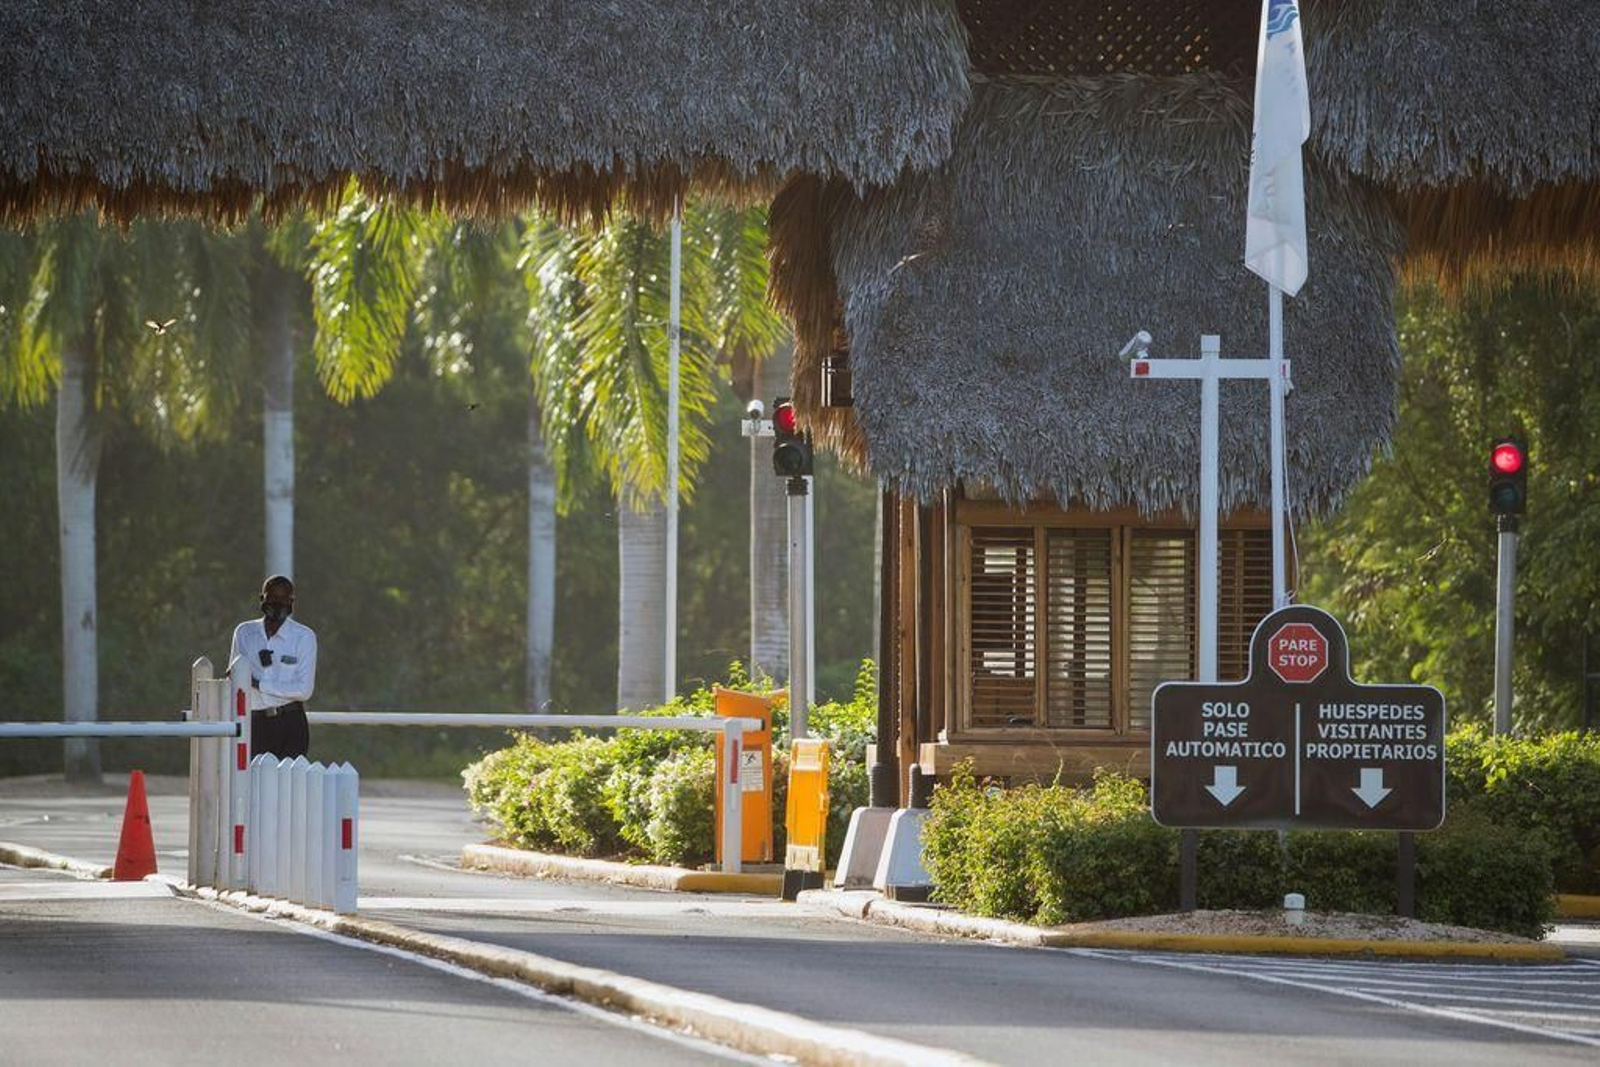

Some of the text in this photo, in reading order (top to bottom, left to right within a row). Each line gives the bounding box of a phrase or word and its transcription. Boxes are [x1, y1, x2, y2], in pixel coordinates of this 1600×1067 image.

[1278, 639, 1318, 652] PARE
[1278, 654, 1319, 667] STOP
[1201, 702, 1250, 719] SOLO
[1319, 704, 1425, 721] HUESPEDES
[1203, 722, 1248, 738] PASE
[1317, 724, 1427, 740] VISITANTES
[1166, 741, 1287, 759] AUTOMATICO
[1305, 743, 1438, 760] PROPIETARIOS
